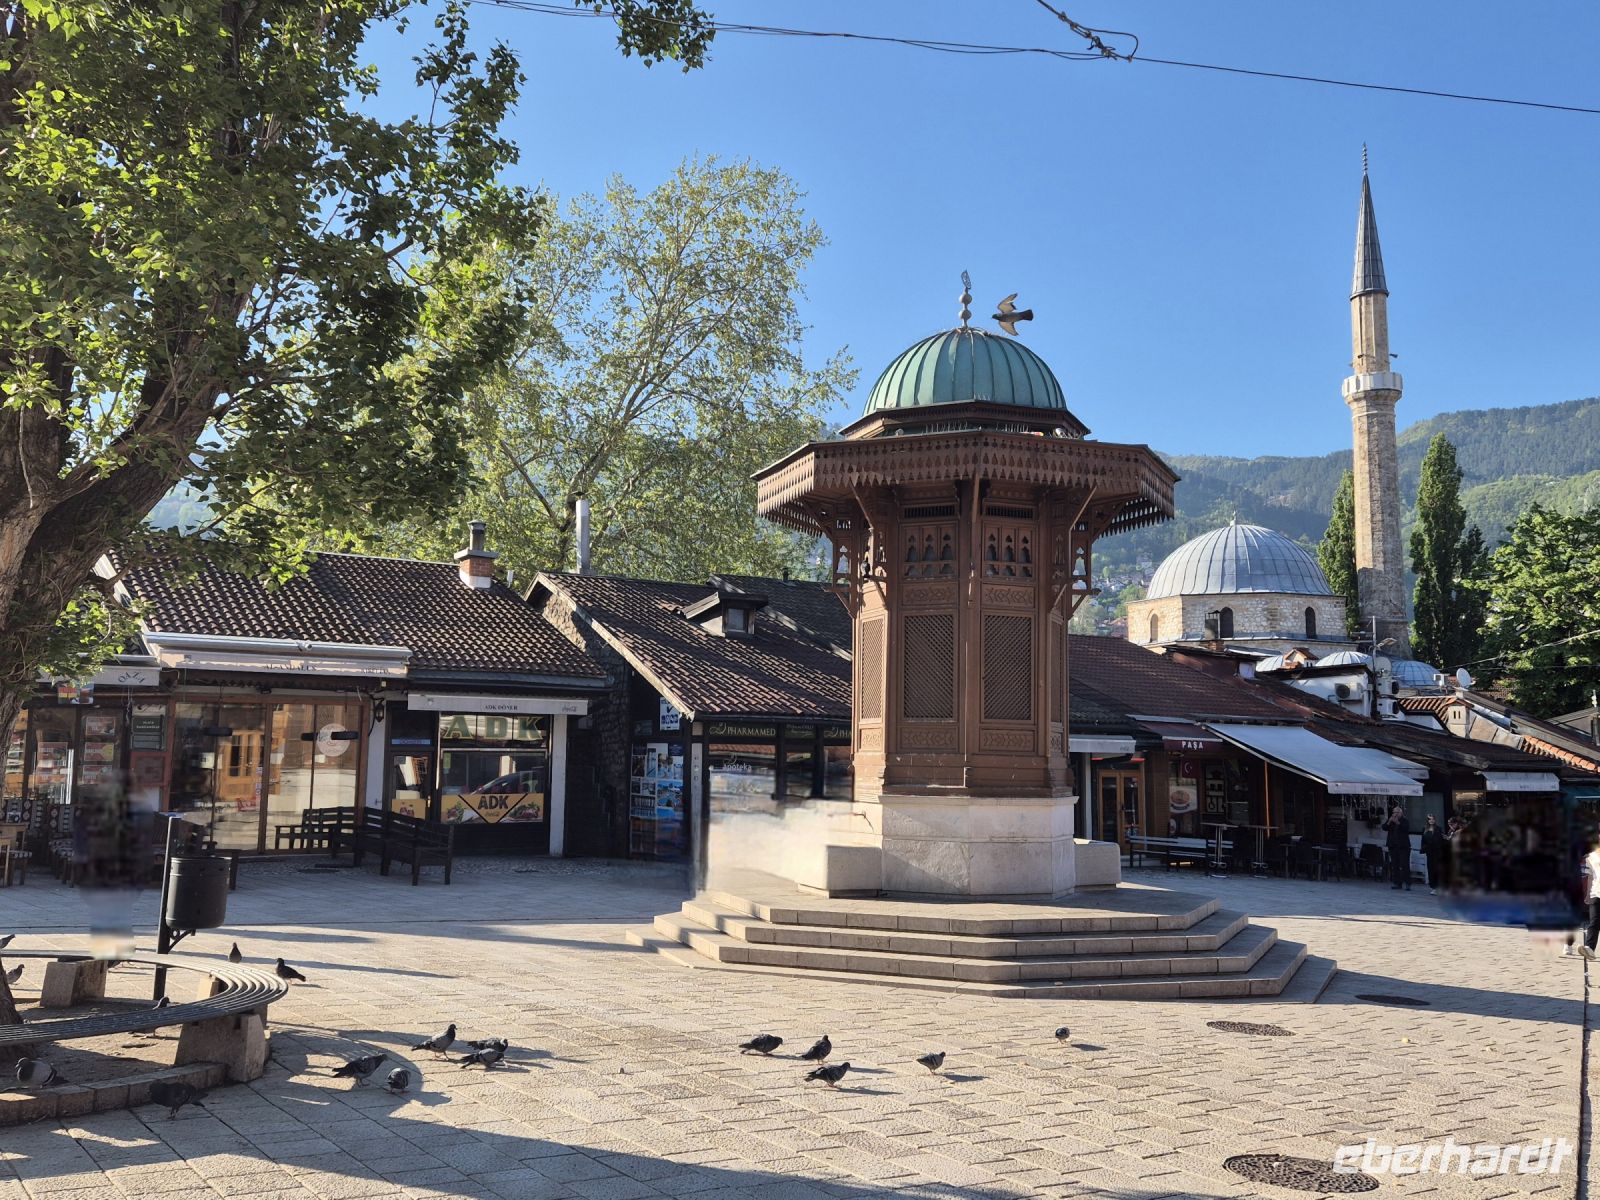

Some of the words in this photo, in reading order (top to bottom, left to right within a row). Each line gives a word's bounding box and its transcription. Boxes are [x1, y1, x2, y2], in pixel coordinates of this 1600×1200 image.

[444, 715, 543, 740] ADK
[727, 726, 776, 736] PHARMAMED
[1181, 740, 1204, 750] PAŞA
[478, 796, 509, 810] ADK
